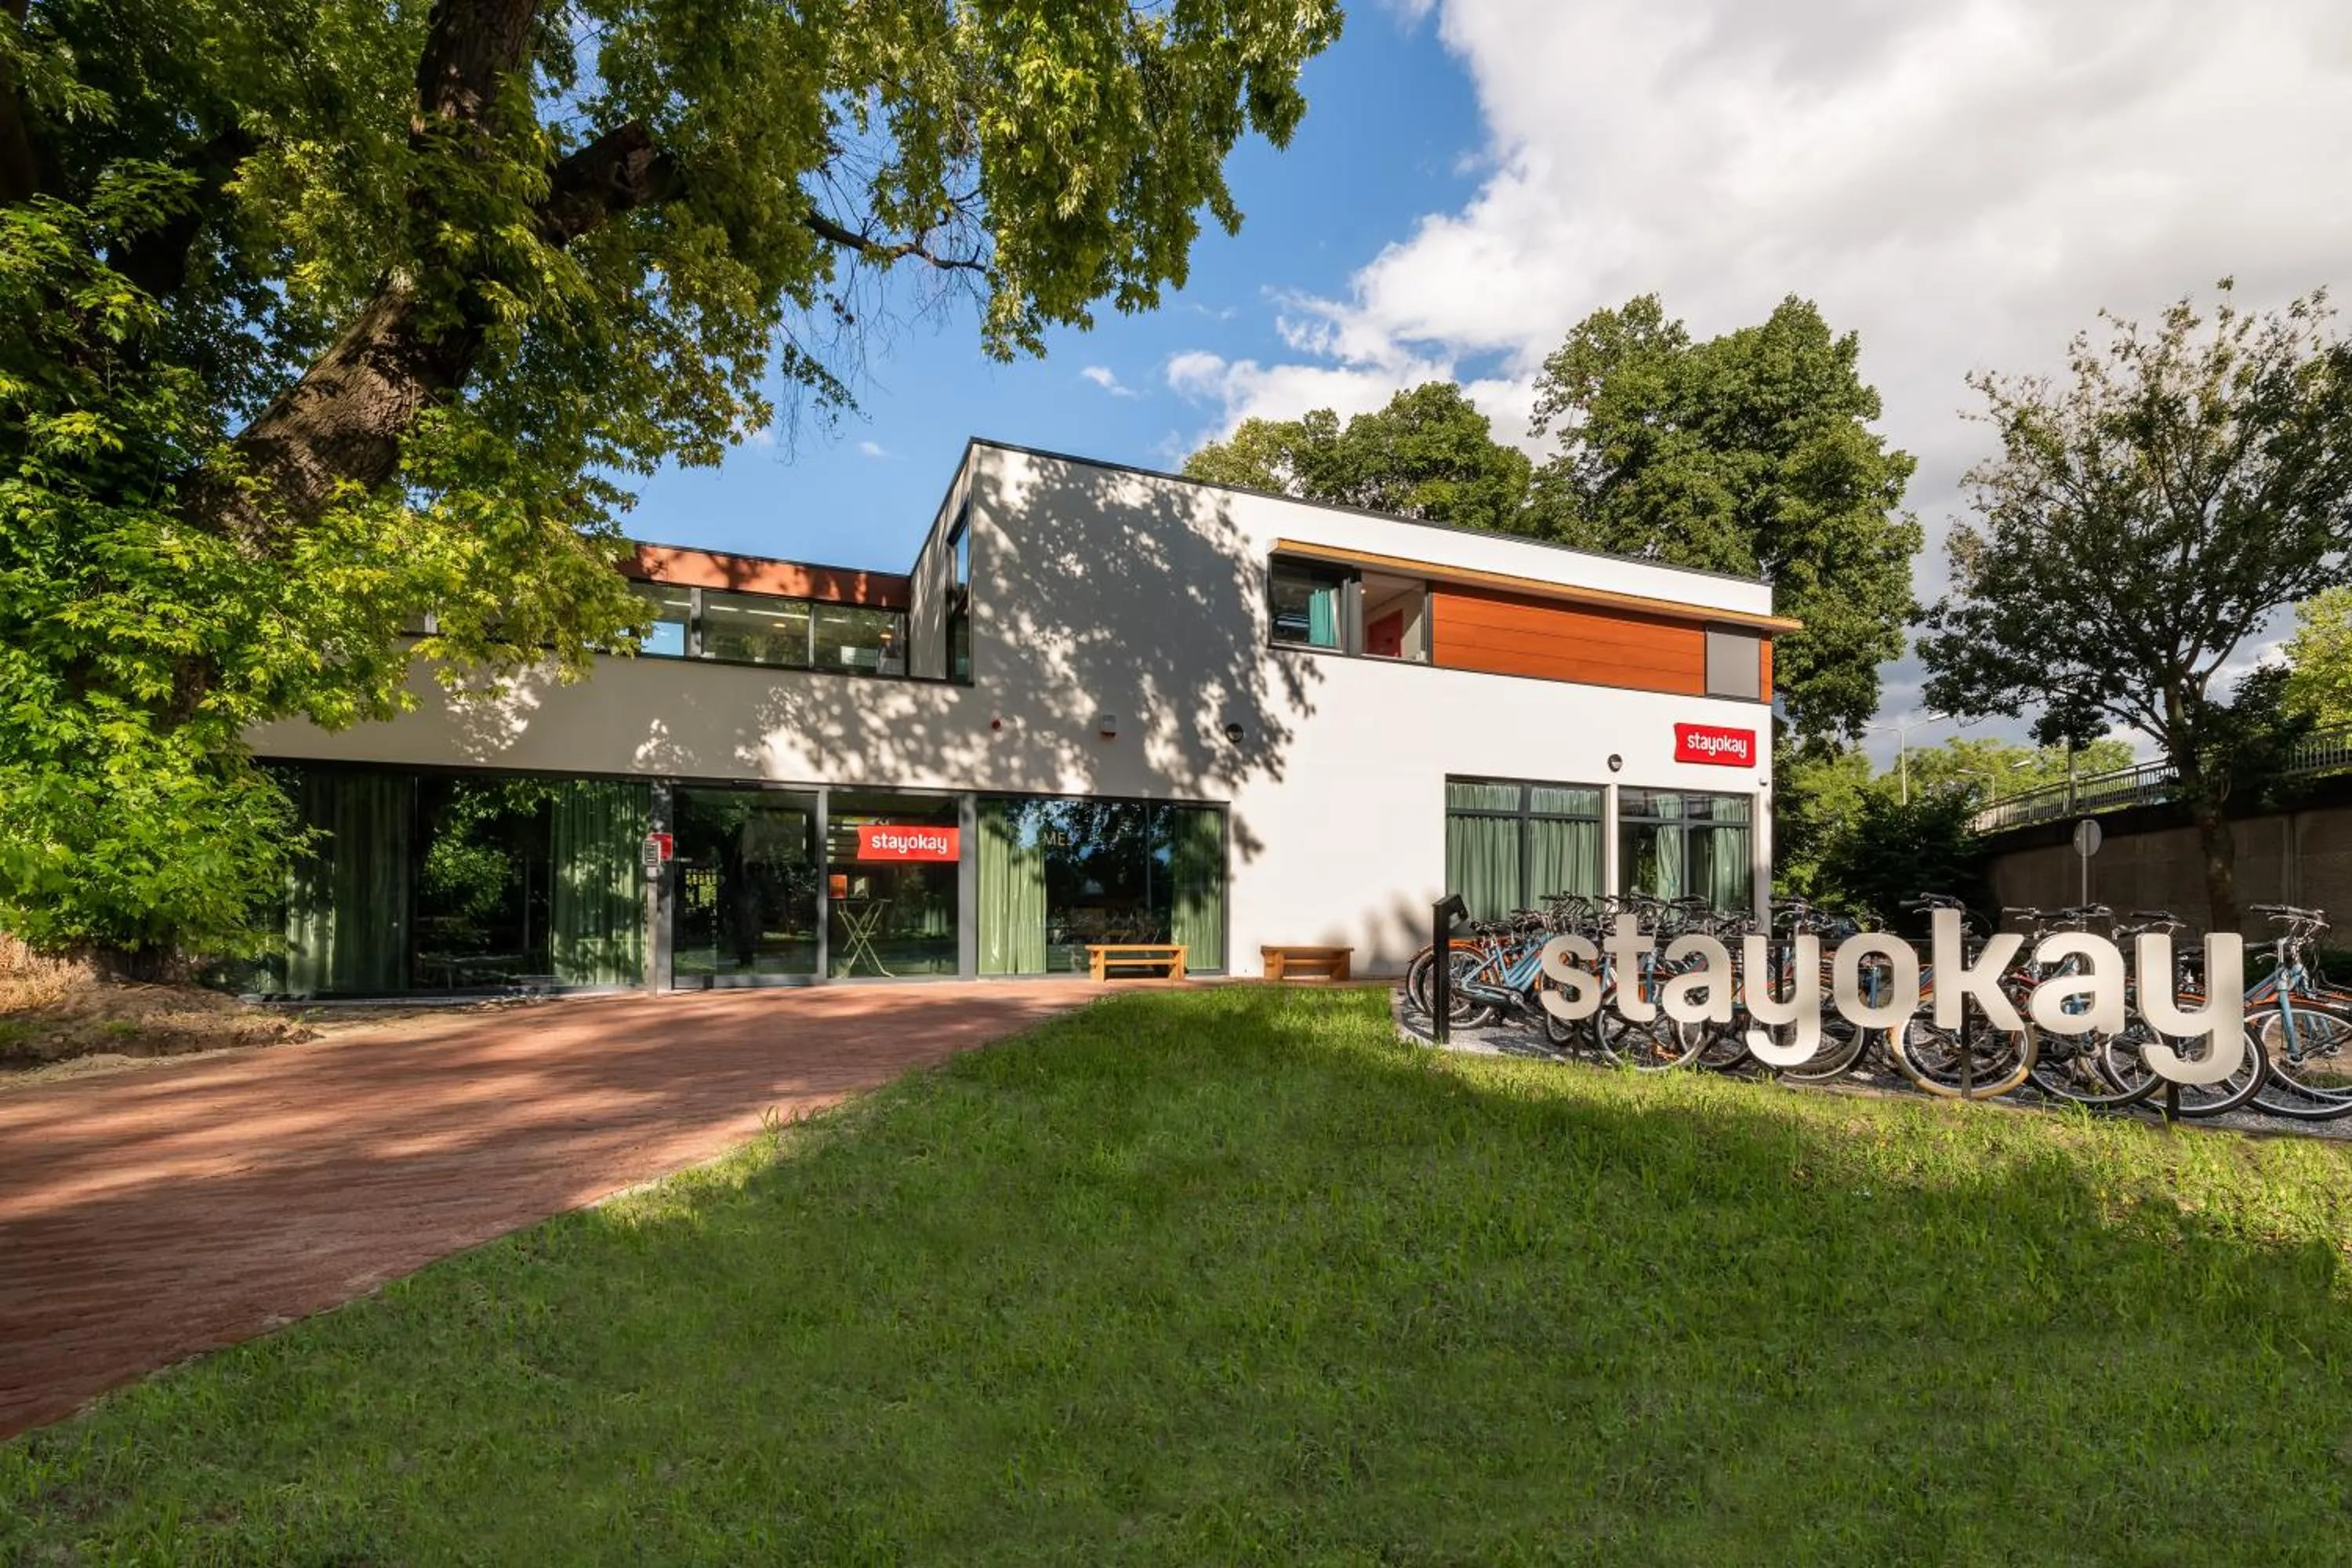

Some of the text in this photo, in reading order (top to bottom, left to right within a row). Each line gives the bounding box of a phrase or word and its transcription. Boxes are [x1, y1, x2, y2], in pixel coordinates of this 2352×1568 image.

[1687, 732, 1747, 757] stayokay
[871, 832, 948, 855] stayokay
[1541, 908, 2245, 1084] stayokay
